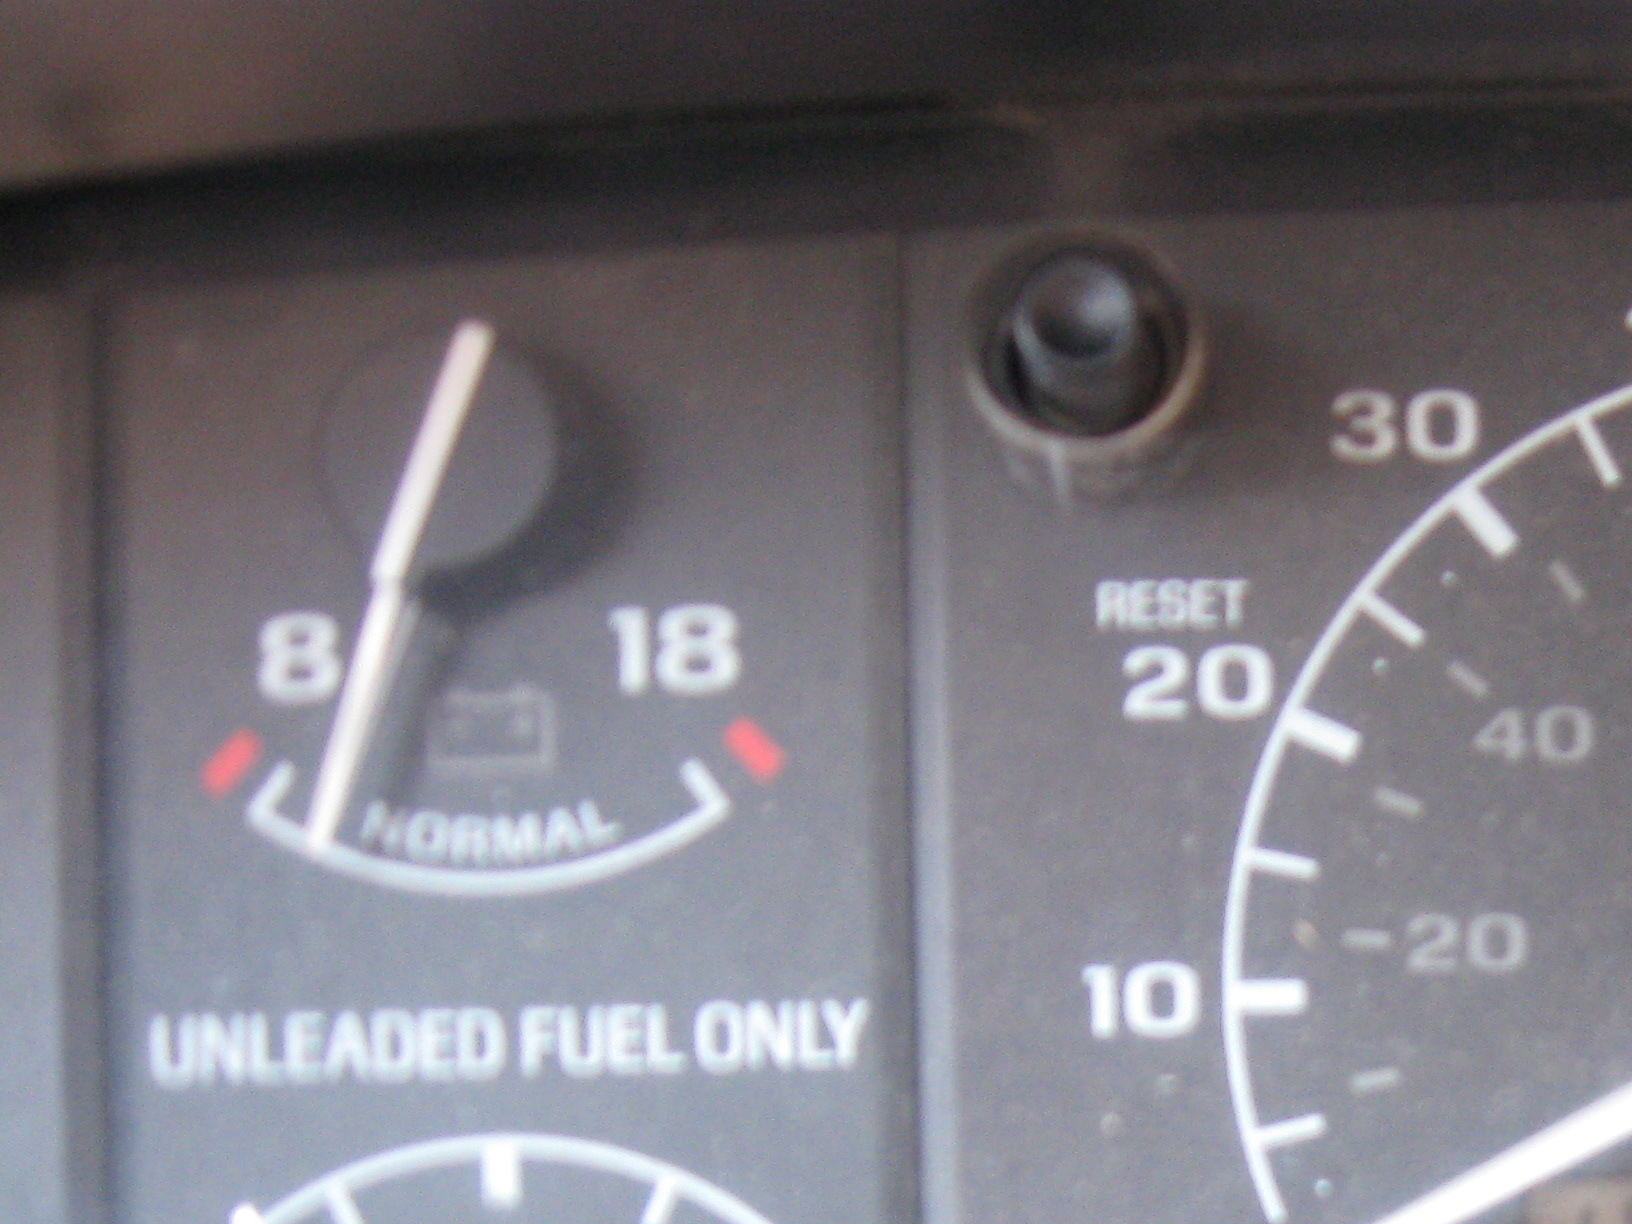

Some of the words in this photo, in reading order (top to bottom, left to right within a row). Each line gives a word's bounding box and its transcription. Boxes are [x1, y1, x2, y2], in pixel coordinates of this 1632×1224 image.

[1330, 388, 1481, 463] 30
[1094, 577, 1250, 631] RESET
[256, 612, 340, 703] 8
[608, 602, 742, 695] 18
[1121, 642, 1275, 722] 20
[1474, 703, 1596, 764] 40
[360, 800, 623, 864] NORMAL
[1405, 910, 1530, 973] 20
[1080, 958, 1202, 1041] 10
[148, 1004, 507, 1091] UNLEADED
[519, 1000, 686, 1080] FUEL
[694, 996, 871, 1076] ONLY
